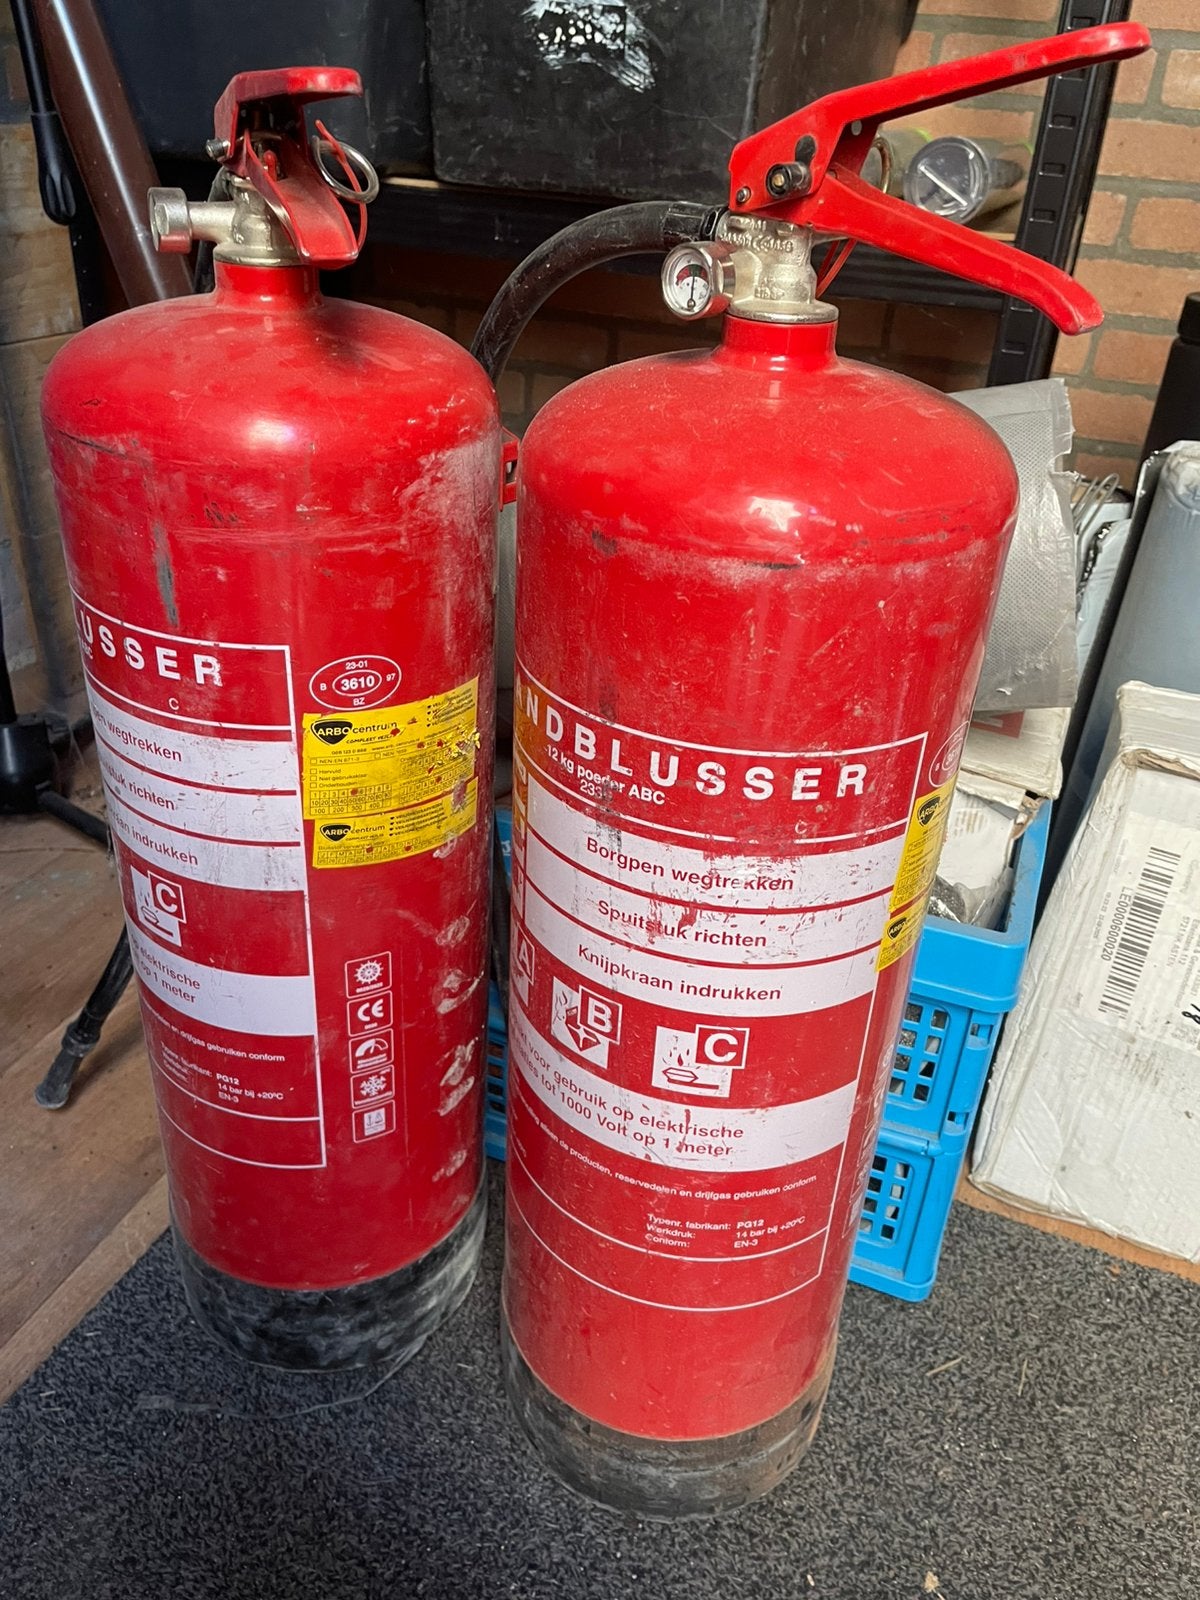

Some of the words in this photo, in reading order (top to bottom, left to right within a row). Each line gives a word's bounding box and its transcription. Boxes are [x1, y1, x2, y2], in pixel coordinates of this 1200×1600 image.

[345, 660, 368, 671] 23-01
[319, 682, 327, 691] B
[340, 675, 375, 691] 3610
[385, 673, 397, 682] 97
[168, 697, 180, 711] C
[107, 721, 183, 762] wegtrekken
[317, 726, 351, 737] ARBO
[560, 749, 575, 775] kg
[577, 764, 626, 794] poeder
[628, 784, 666, 805] ABC
[128, 781, 176, 811] richten
[325, 828, 350, 836] ARBO
[350, 825, 386, 834] centrum
[794, 820, 809, 836] C
[132, 828, 199, 866] indrukken
[586, 836, 665, 878] Borgpen
[671, 867, 795, 892] wegtrekken
[156, 882, 178, 913] C
[597, 899, 688, 941] Spuitstuk
[694, 928, 768, 948] richten
[1100, 886, 1134, 962] LE0000600020
[140, 946, 200, 989] elektrische
[518, 937, 532, 978] A
[578, 943, 674, 992] Knijpkraan
[679, 980, 782, 1001] indrukken
[161, 979, 197, 1003] meter
[357, 998, 384, 1022] CE
[587, 996, 613, 1034] B
[206, 1042, 247, 1058] gebruiken
[248, 1051, 286, 1062] conform
[703, 1032, 739, 1063] C
[216, 1073, 240, 1086] PG12
[218, 1083, 228, 1092] 14
[228, 1085, 243, 1095] bar
[244, 1089, 256, 1099] bij
[528, 1041, 551, 1072] voor
[553, 1070, 608, 1111] gebruik
[612, 1105, 635, 1122] op
[639, 1114, 745, 1139] elektrische
[541, 1073, 556, 1096] tot
[561, 1092, 592, 1119] 1000
[596, 1112, 628, 1137] Volt
[633, 1130, 656, 1148] op
[663, 1136, 670, 1149] 1
[678, 1139, 734, 1157] meter
[615, 1171, 678, 1195] reservedelen
[679, 1189, 692, 1197] en
[694, 1189, 732, 1202] drijfgas
[733, 1186, 781, 1200] gebruiken
[781, 1174, 817, 1191] conform
[646, 1212, 683, 1229] Typenr.
[685, 1220, 732, 1231] fabrikant:
[736, 1218, 765, 1229] PG12
[646, 1222, 696, 1240] Werkdruk:
[736, 1230, 747, 1239] 14
[749, 1227, 766, 1237] bar
[767, 1224, 778, 1235] bij
[644, 1233, 690, 1249] Conform:
[733, 1238, 759, 1249] EN-3
